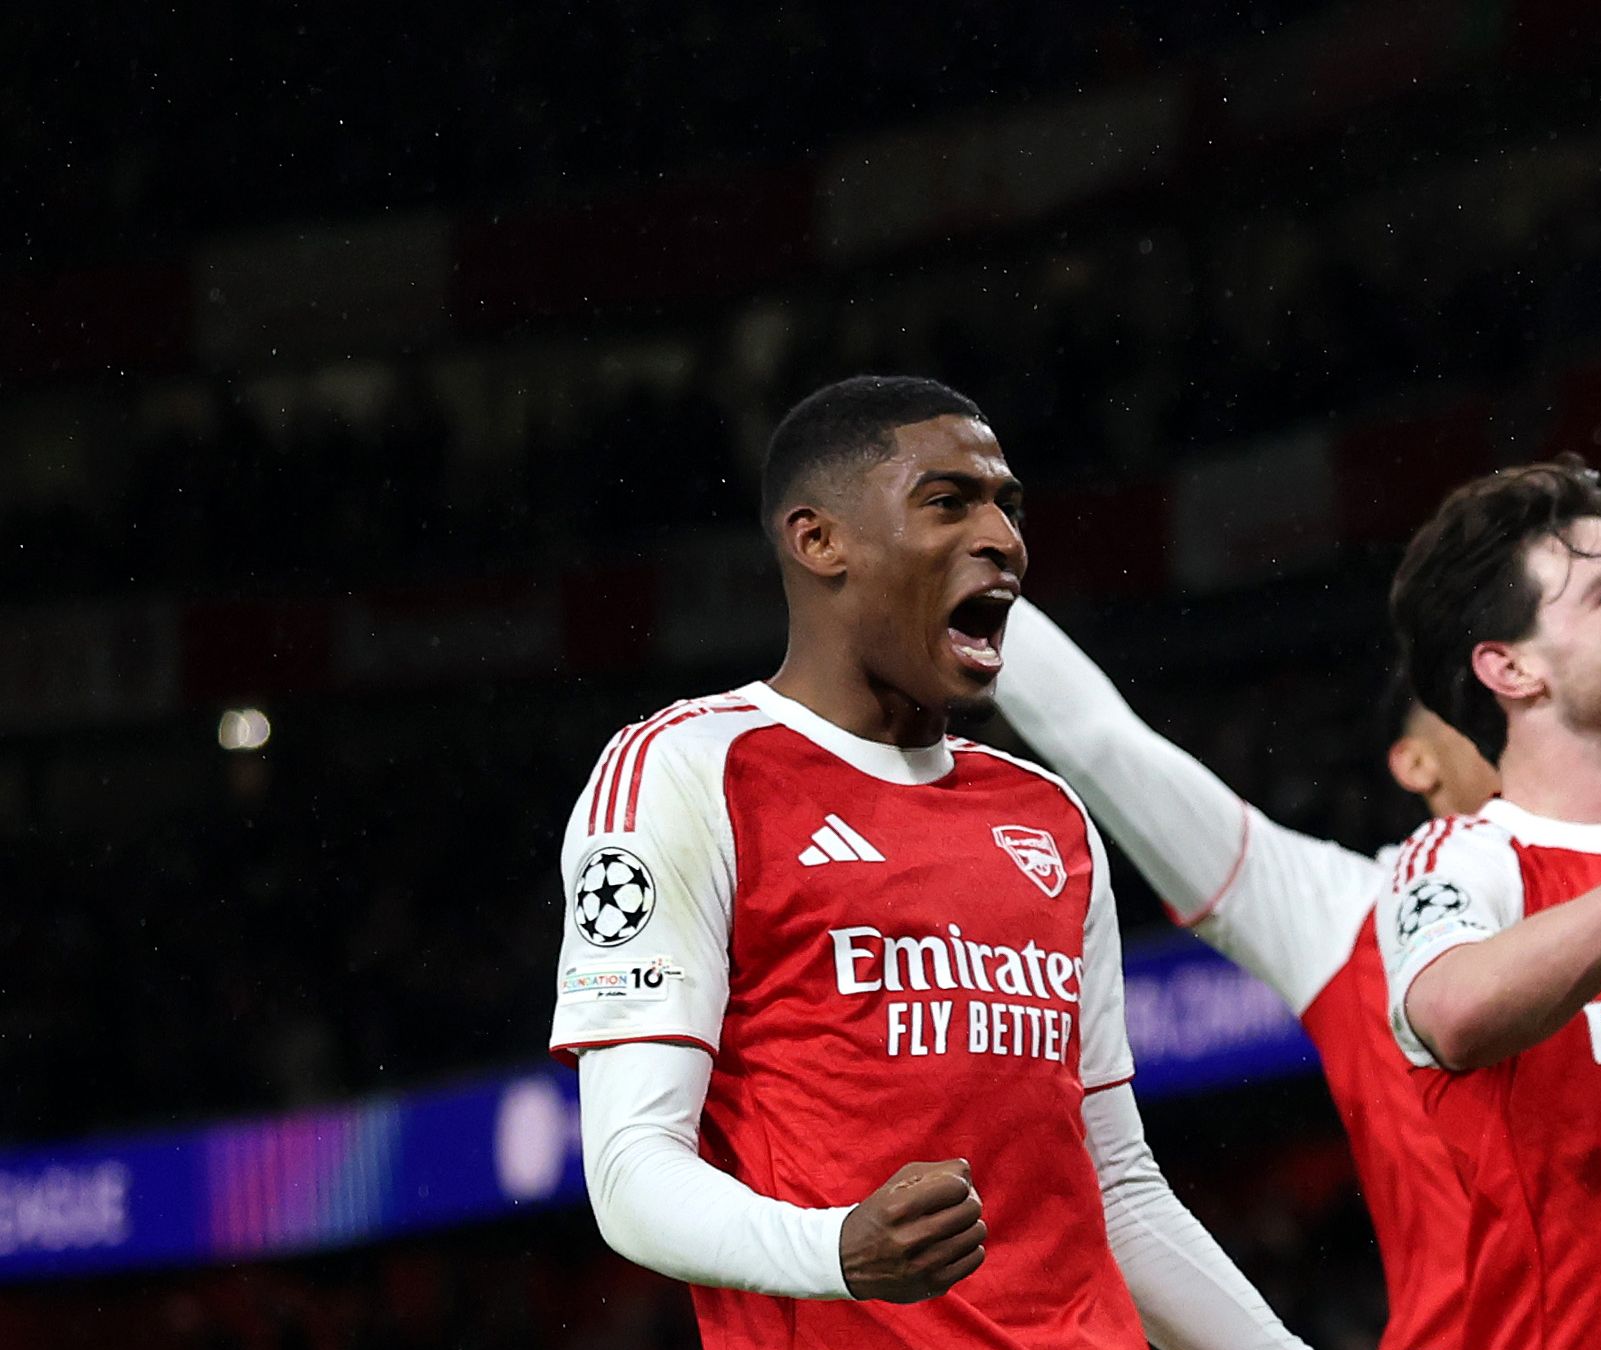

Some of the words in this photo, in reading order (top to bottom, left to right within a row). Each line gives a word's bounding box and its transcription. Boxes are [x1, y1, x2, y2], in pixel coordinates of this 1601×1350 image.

[630, 967, 663, 989] 10
[888, 1001, 953, 1056] FLY
[967, 1001, 1072, 1066] BETTER
